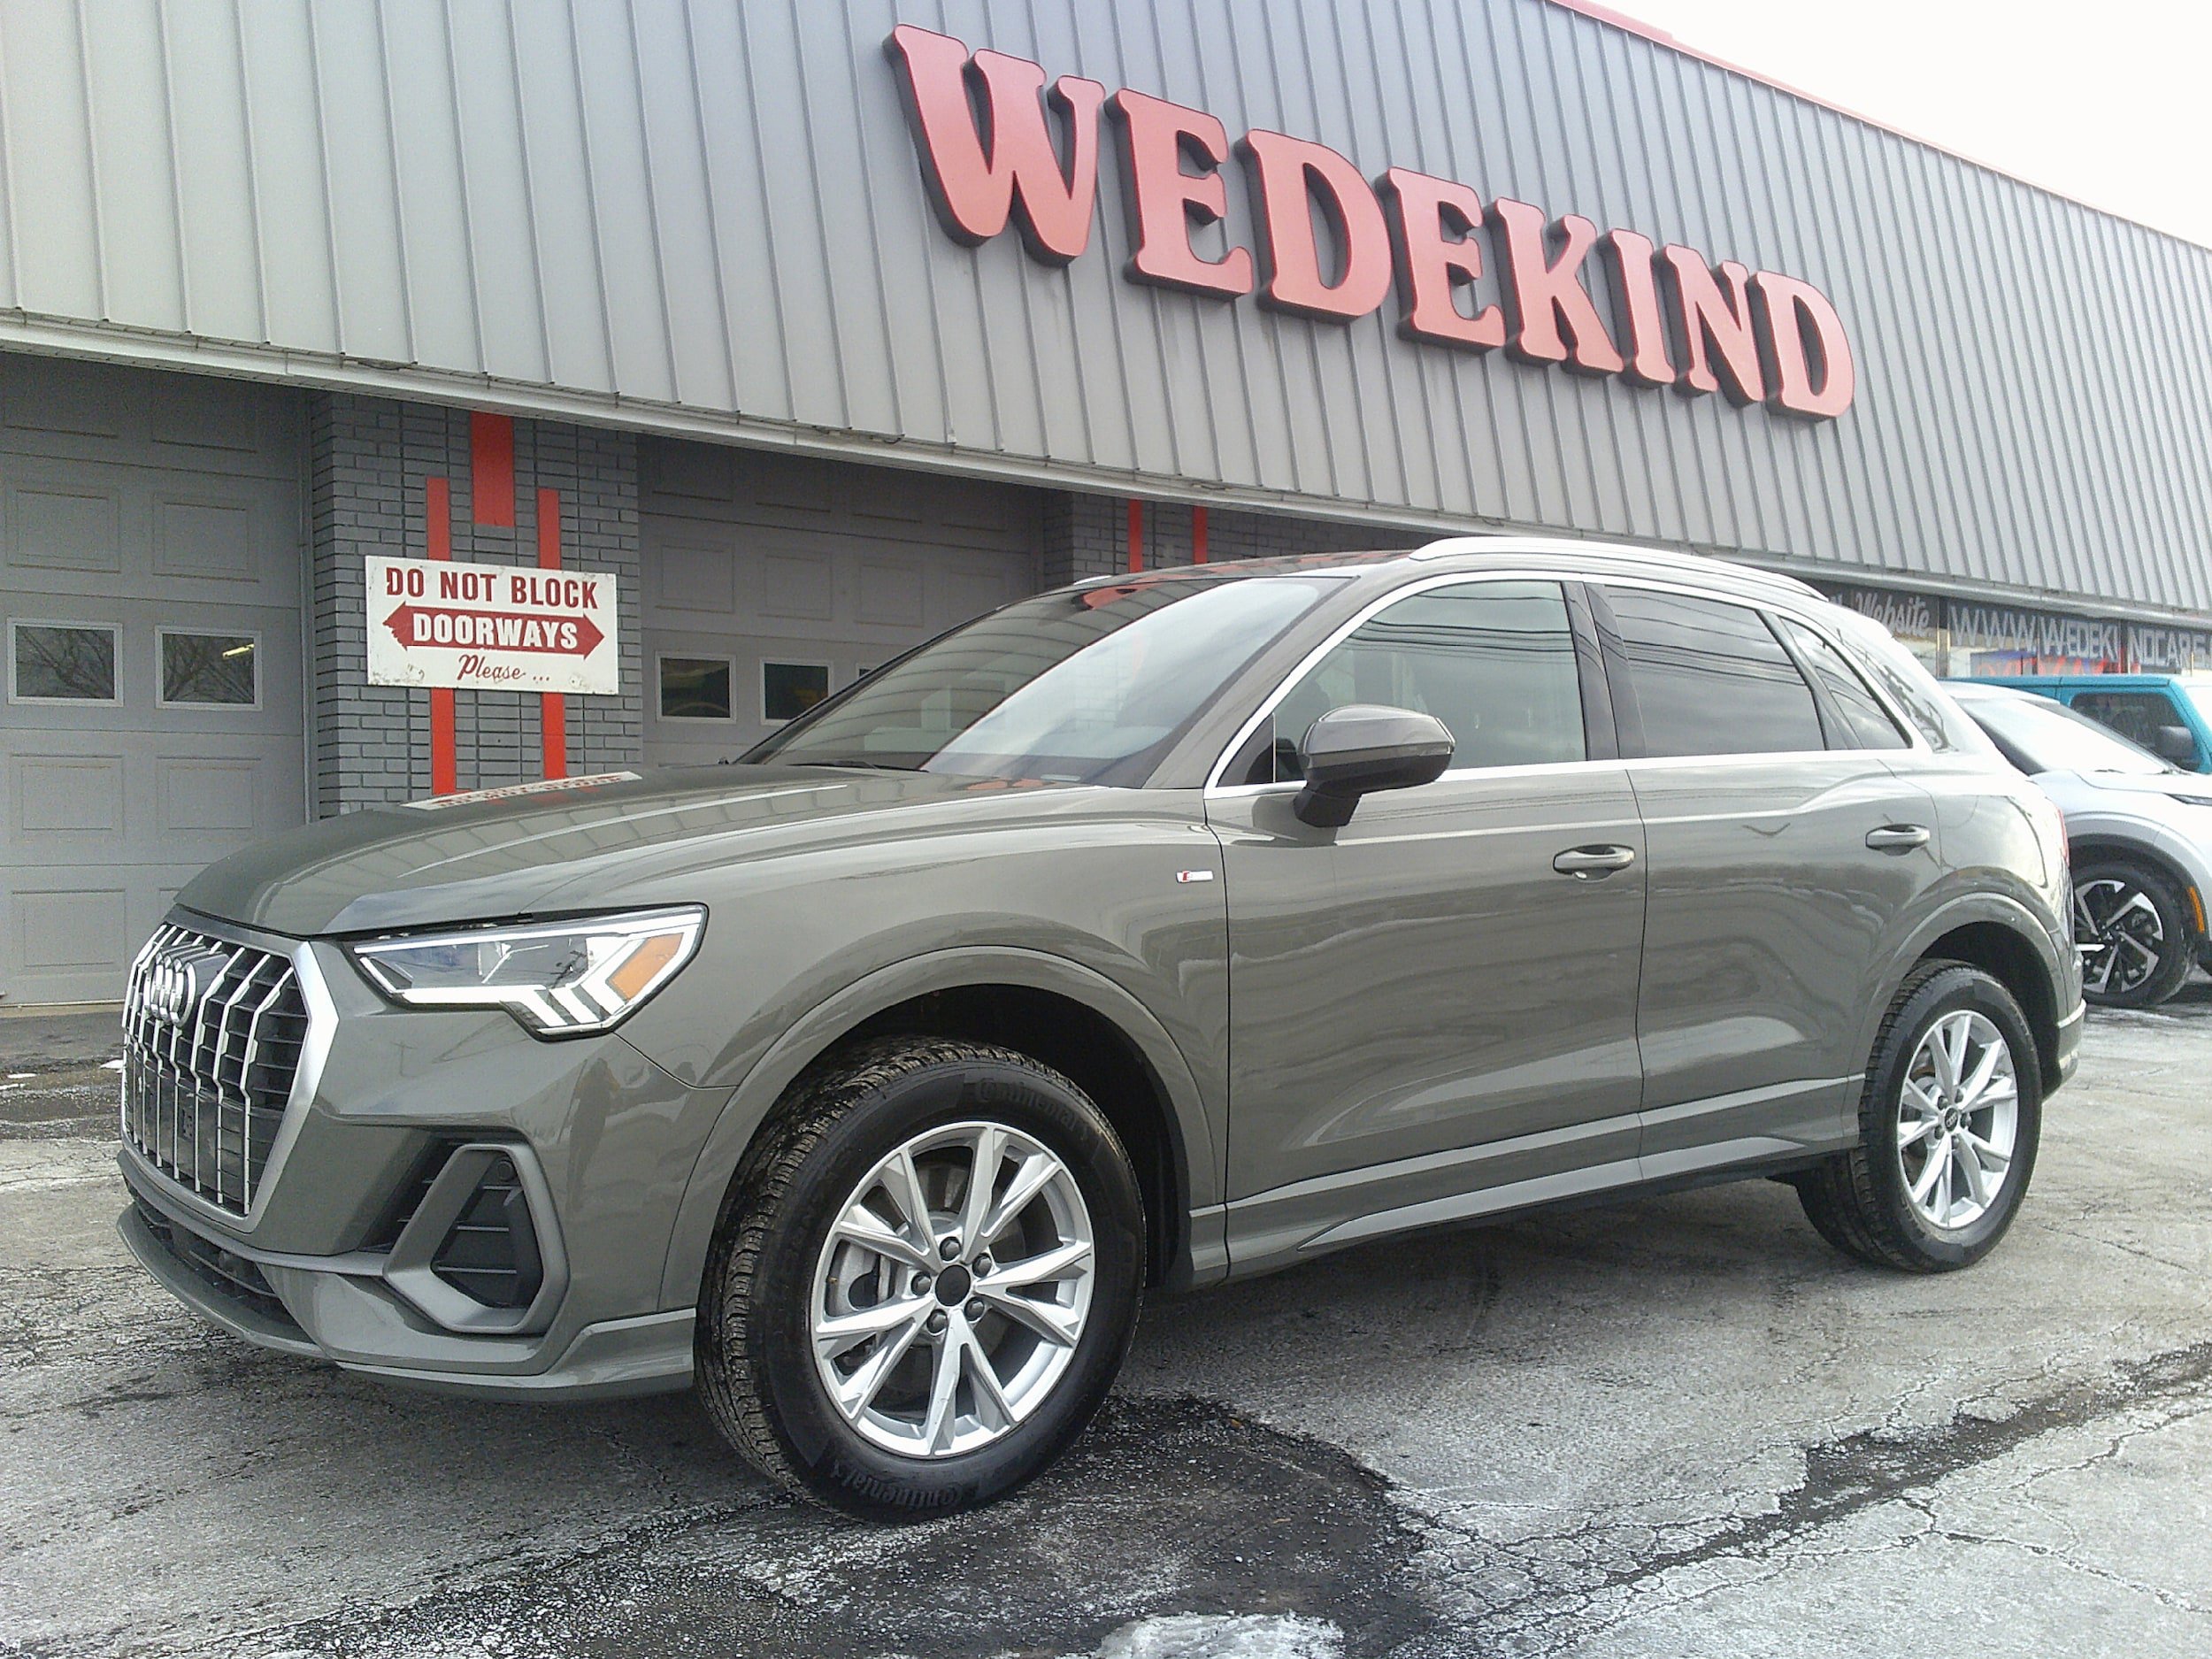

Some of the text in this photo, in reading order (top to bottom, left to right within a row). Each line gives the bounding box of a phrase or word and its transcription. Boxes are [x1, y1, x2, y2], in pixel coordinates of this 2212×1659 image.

[887, 24, 1855, 419] WEDEKIND
[386, 566, 599, 610] DO NOT BLOCK
[413, 613, 579, 649] DOORWAYS
[1855, 592, 1930, 637] Website
[457, 654, 526, 683] Please
